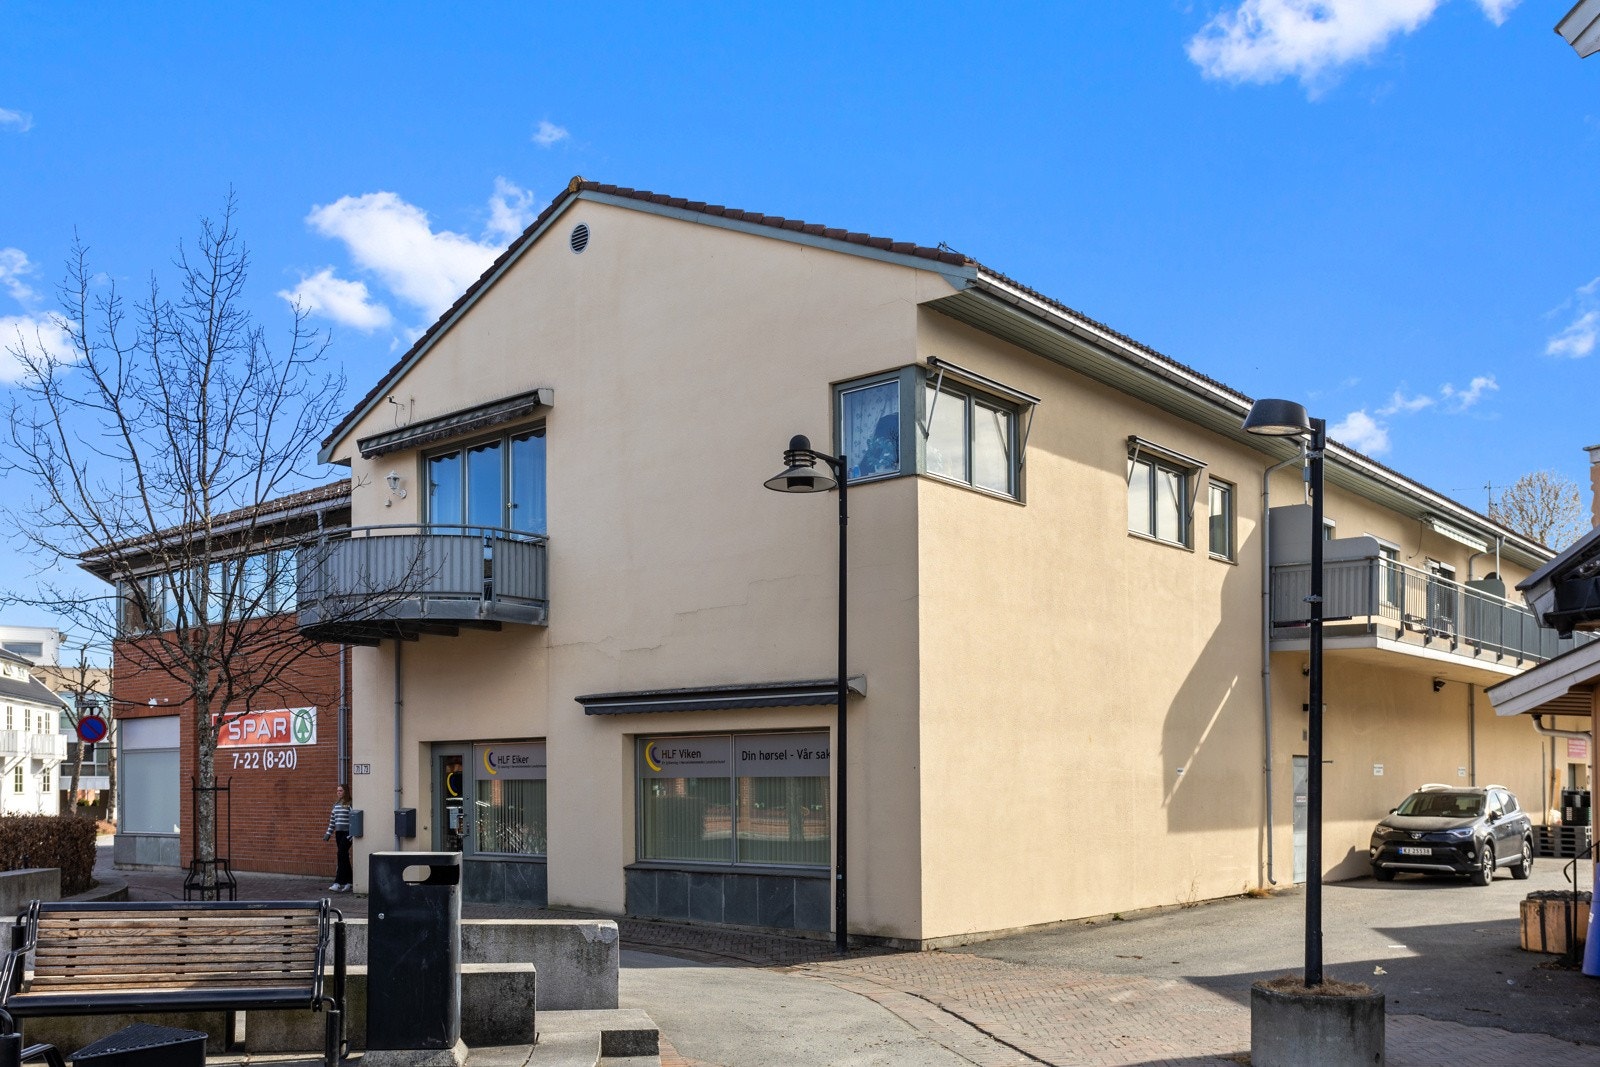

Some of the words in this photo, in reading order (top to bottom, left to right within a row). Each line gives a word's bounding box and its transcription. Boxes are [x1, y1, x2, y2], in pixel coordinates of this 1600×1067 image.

[228, 717, 287, 740] SPAR
[232, 752, 259, 769] 7-22
[263, 747, 297, 771] (8-20)
[497, 755, 510, 765] HLF
[511, 755, 529, 764] Eiker
[661, 749, 677, 759] HLF
[678, 748, 702, 759] Viken
[741, 750, 756, 761] Din
[759, 749, 787, 760] hørsel
[796, 747, 813, 760] Vår
